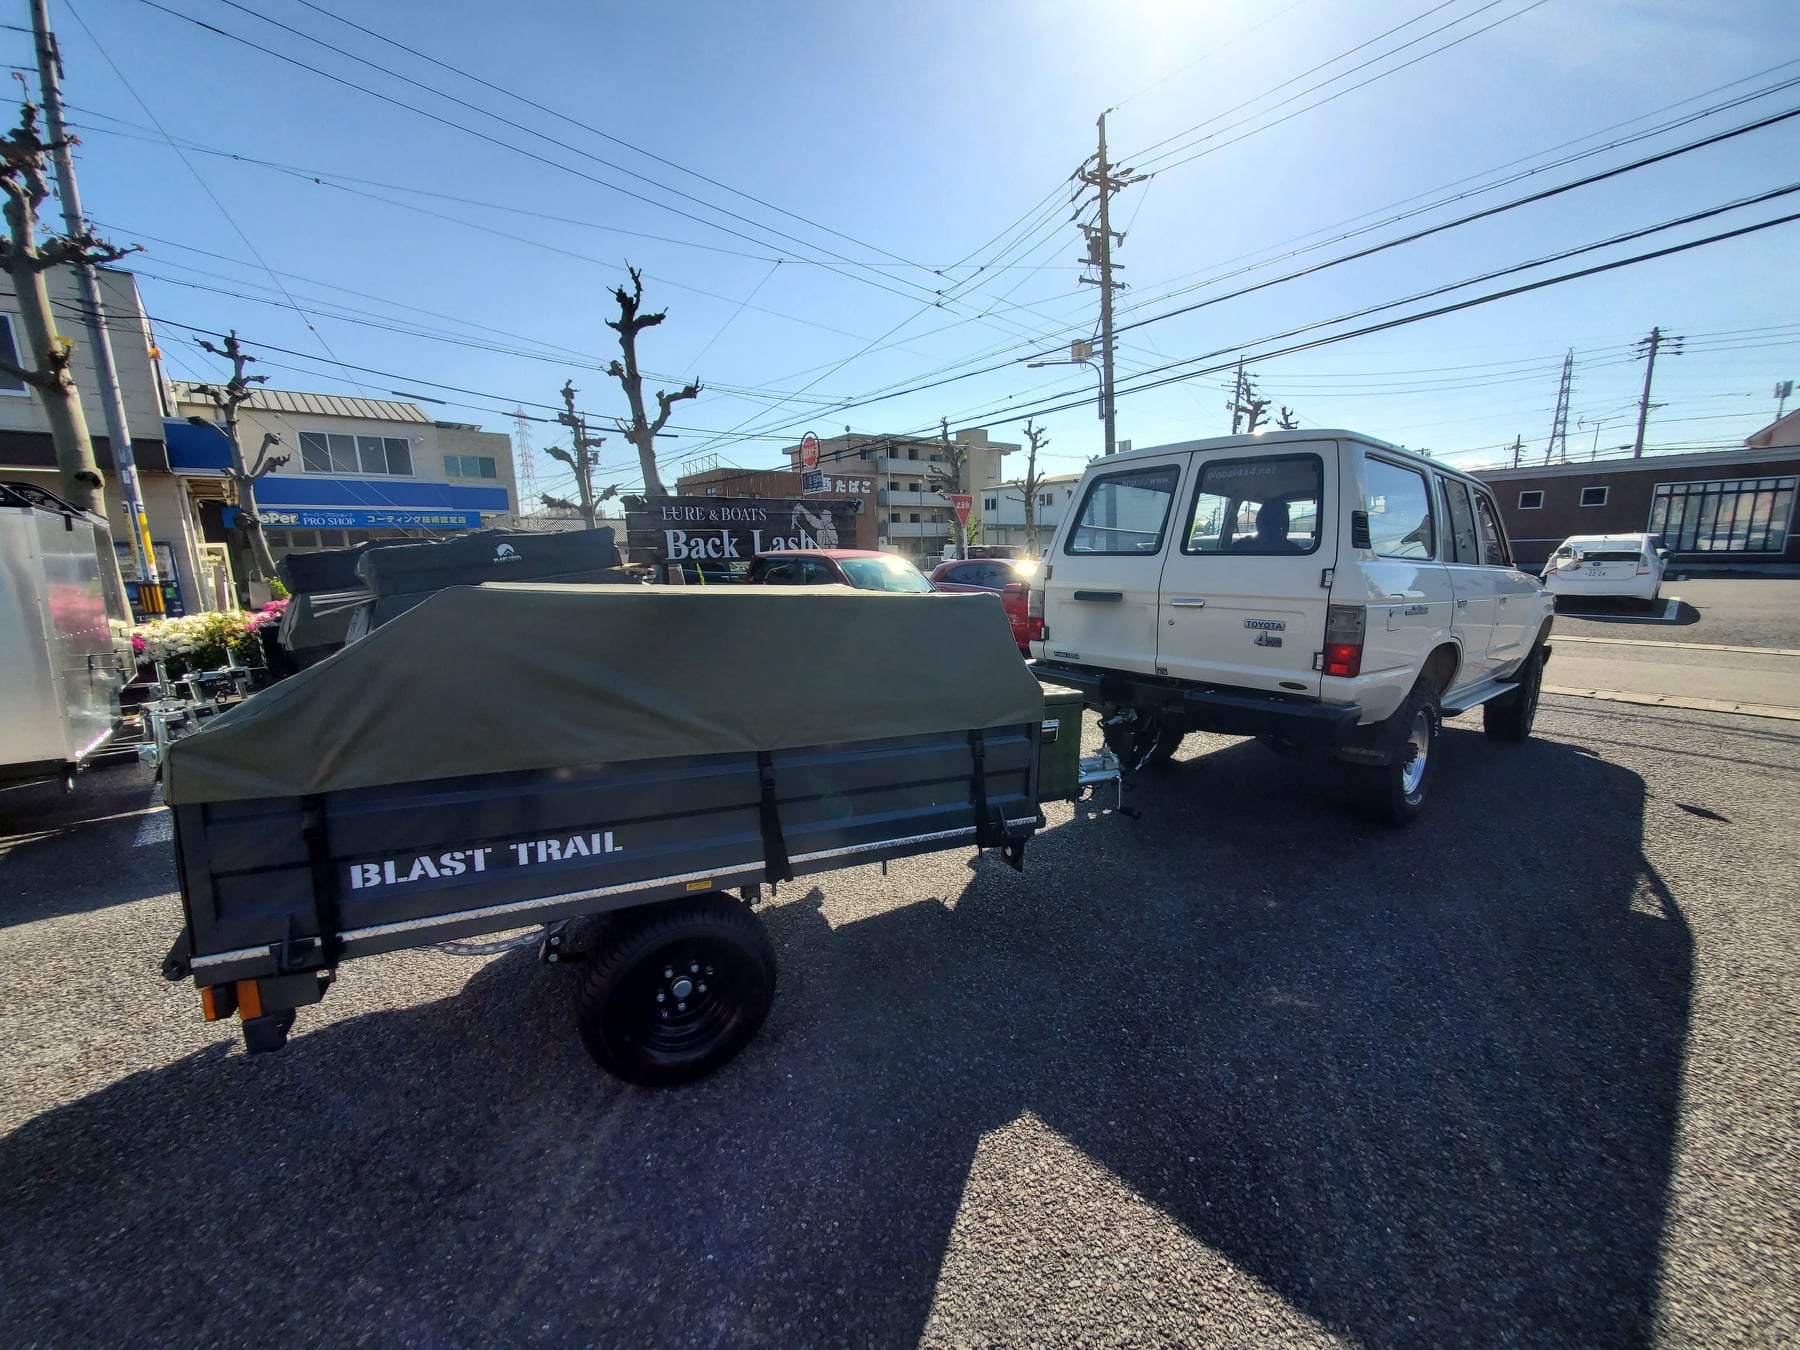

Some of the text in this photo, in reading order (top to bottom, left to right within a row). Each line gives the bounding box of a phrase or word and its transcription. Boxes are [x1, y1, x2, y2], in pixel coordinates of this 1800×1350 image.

[661, 506, 767, 521] LURE & BOATS
[303, 517, 356, 526] PRO SHOP
[664, 529, 813, 560] Back Lash
[1246, 620, 1282, 629] TOYOTA
[350, 831, 624, 889] BLAST TRAIL
